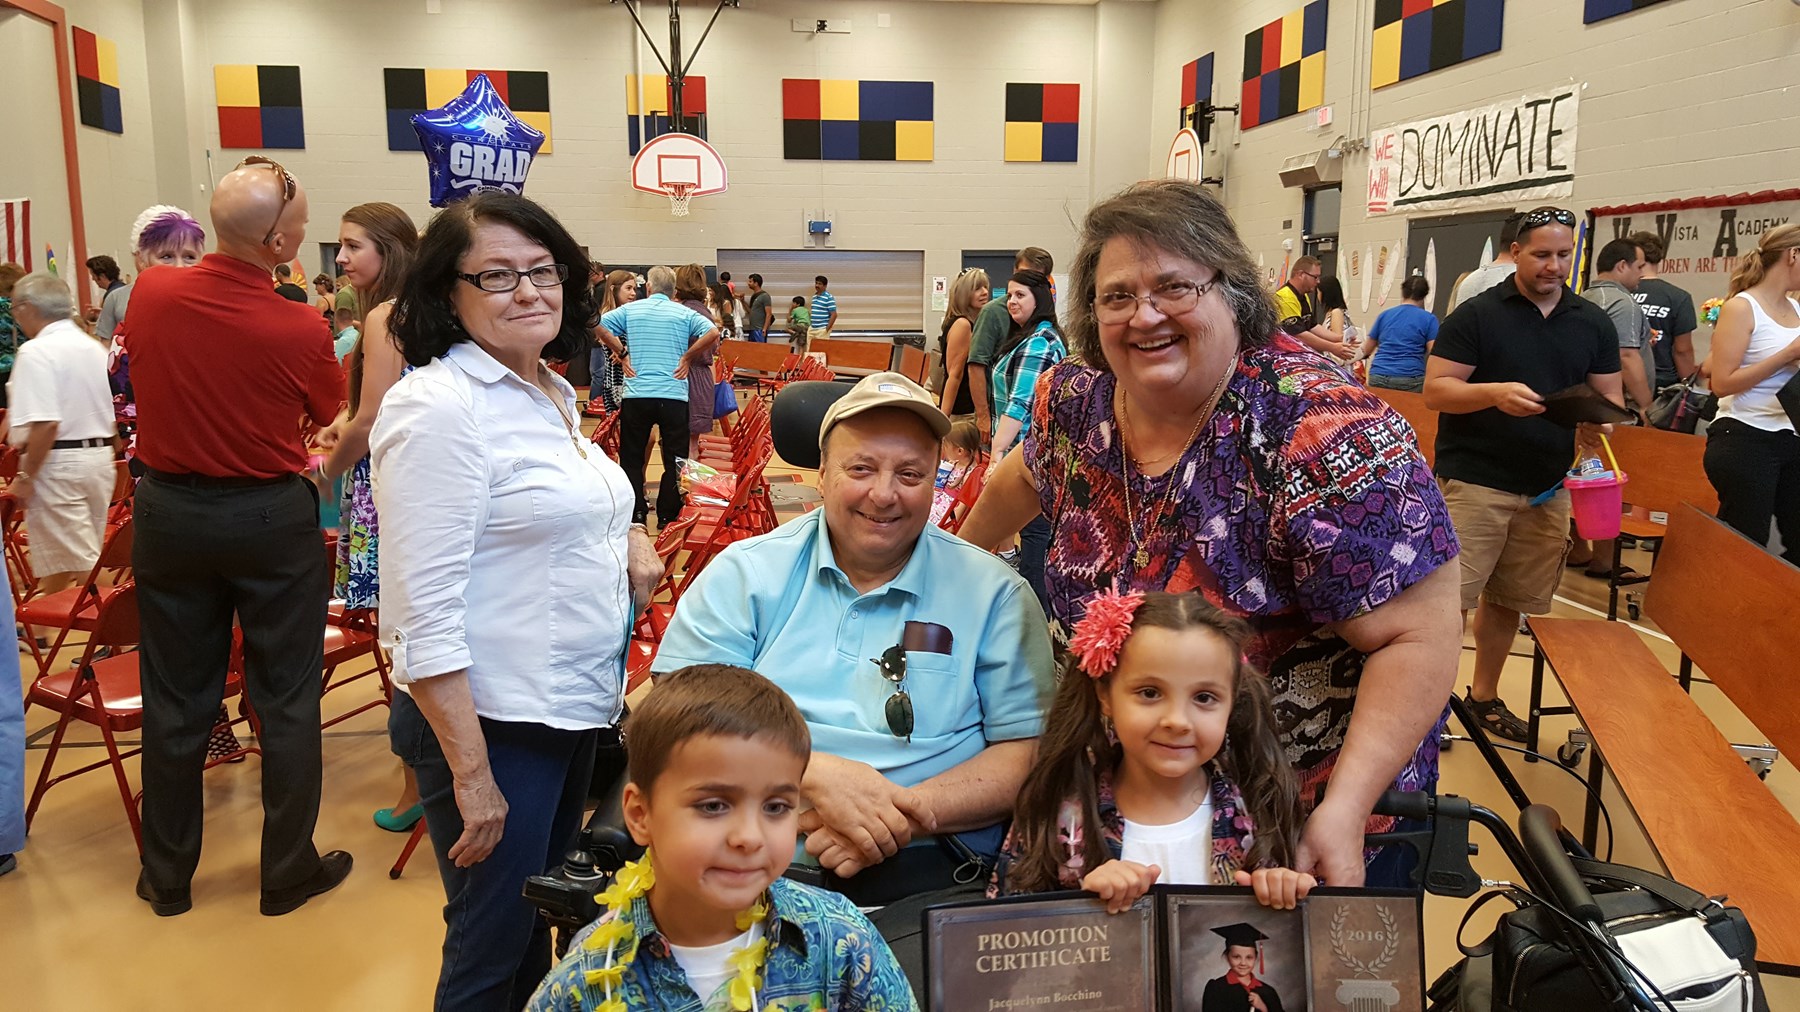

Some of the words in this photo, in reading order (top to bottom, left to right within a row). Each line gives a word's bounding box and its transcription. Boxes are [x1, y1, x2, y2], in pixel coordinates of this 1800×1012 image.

[1375, 134, 1395, 162] WE
[1399, 92, 1573, 197] DOMINATE
[450, 142, 531, 182] GRAD
[1695, 256, 1717, 273] ARE
[977, 925, 1109, 951] PROMOTION
[1346, 930, 1384, 941] 2016
[976, 945, 1112, 973] CERTIFICATE
[1053, 988, 1103, 1003] Bocchino
